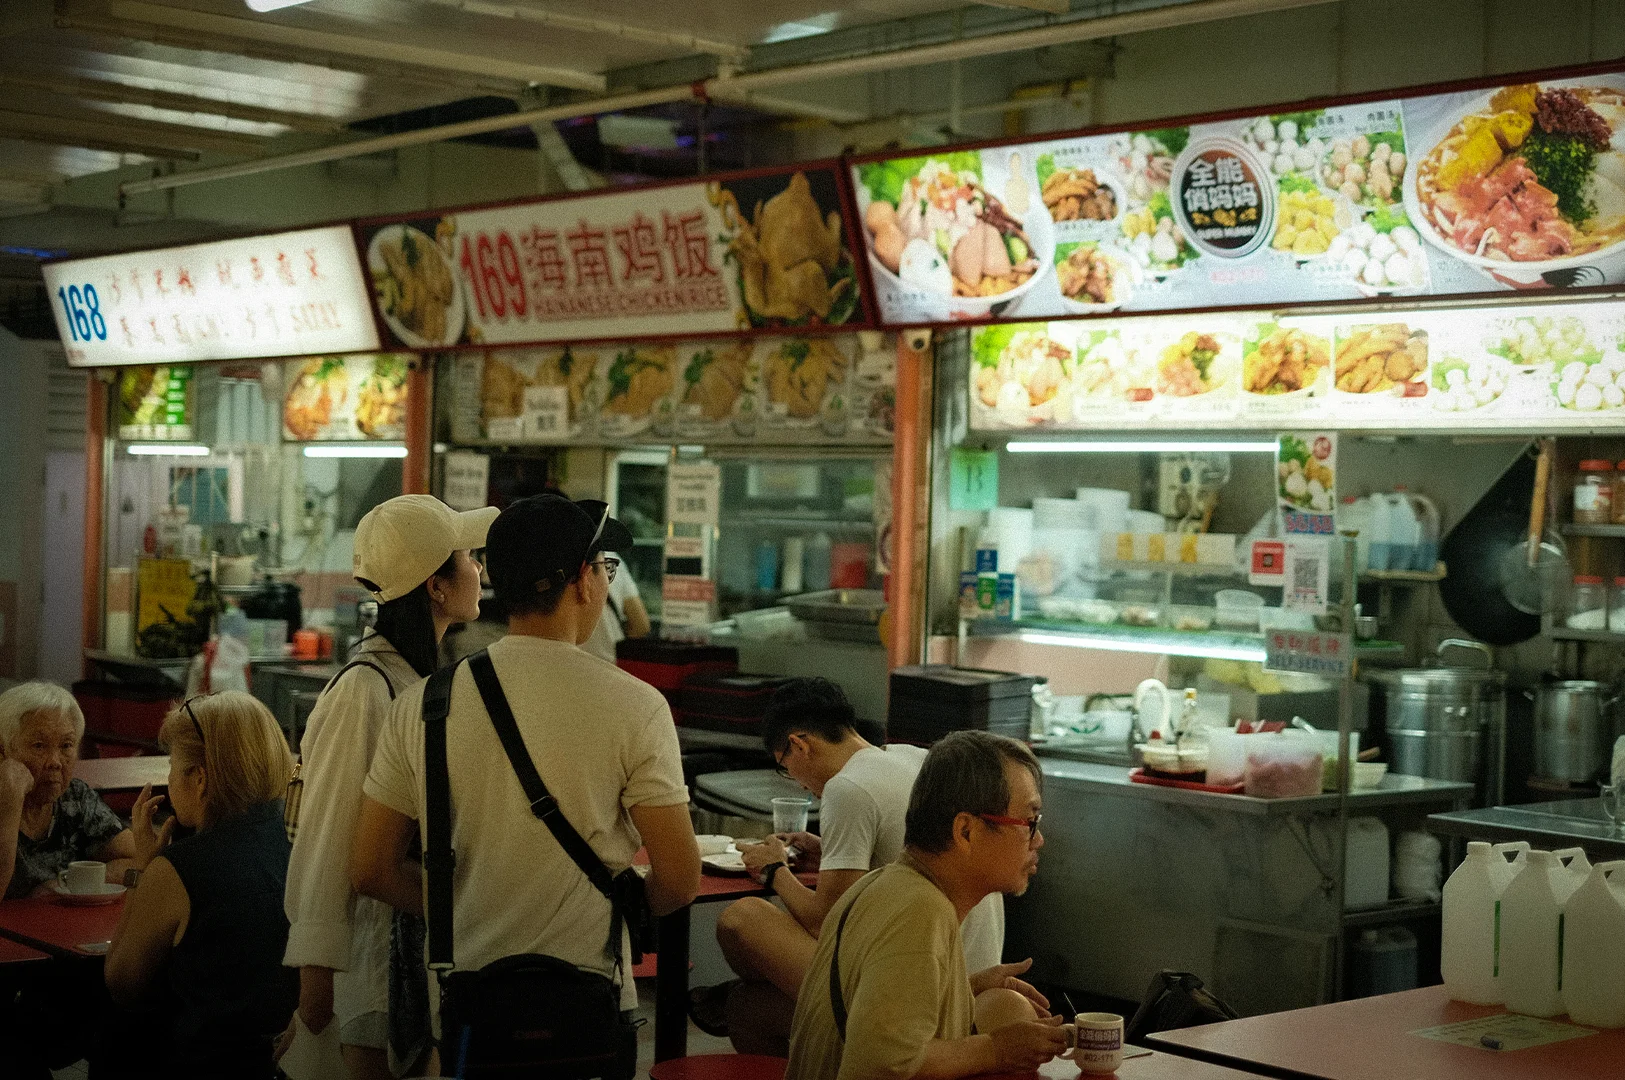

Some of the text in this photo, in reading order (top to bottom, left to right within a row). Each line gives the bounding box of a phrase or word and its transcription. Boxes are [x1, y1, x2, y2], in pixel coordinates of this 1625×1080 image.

[1188, 158, 1244, 187] 全能
[462, 213, 718, 317] 169 海南鸡饭
[58, 283, 107, 343] 168
